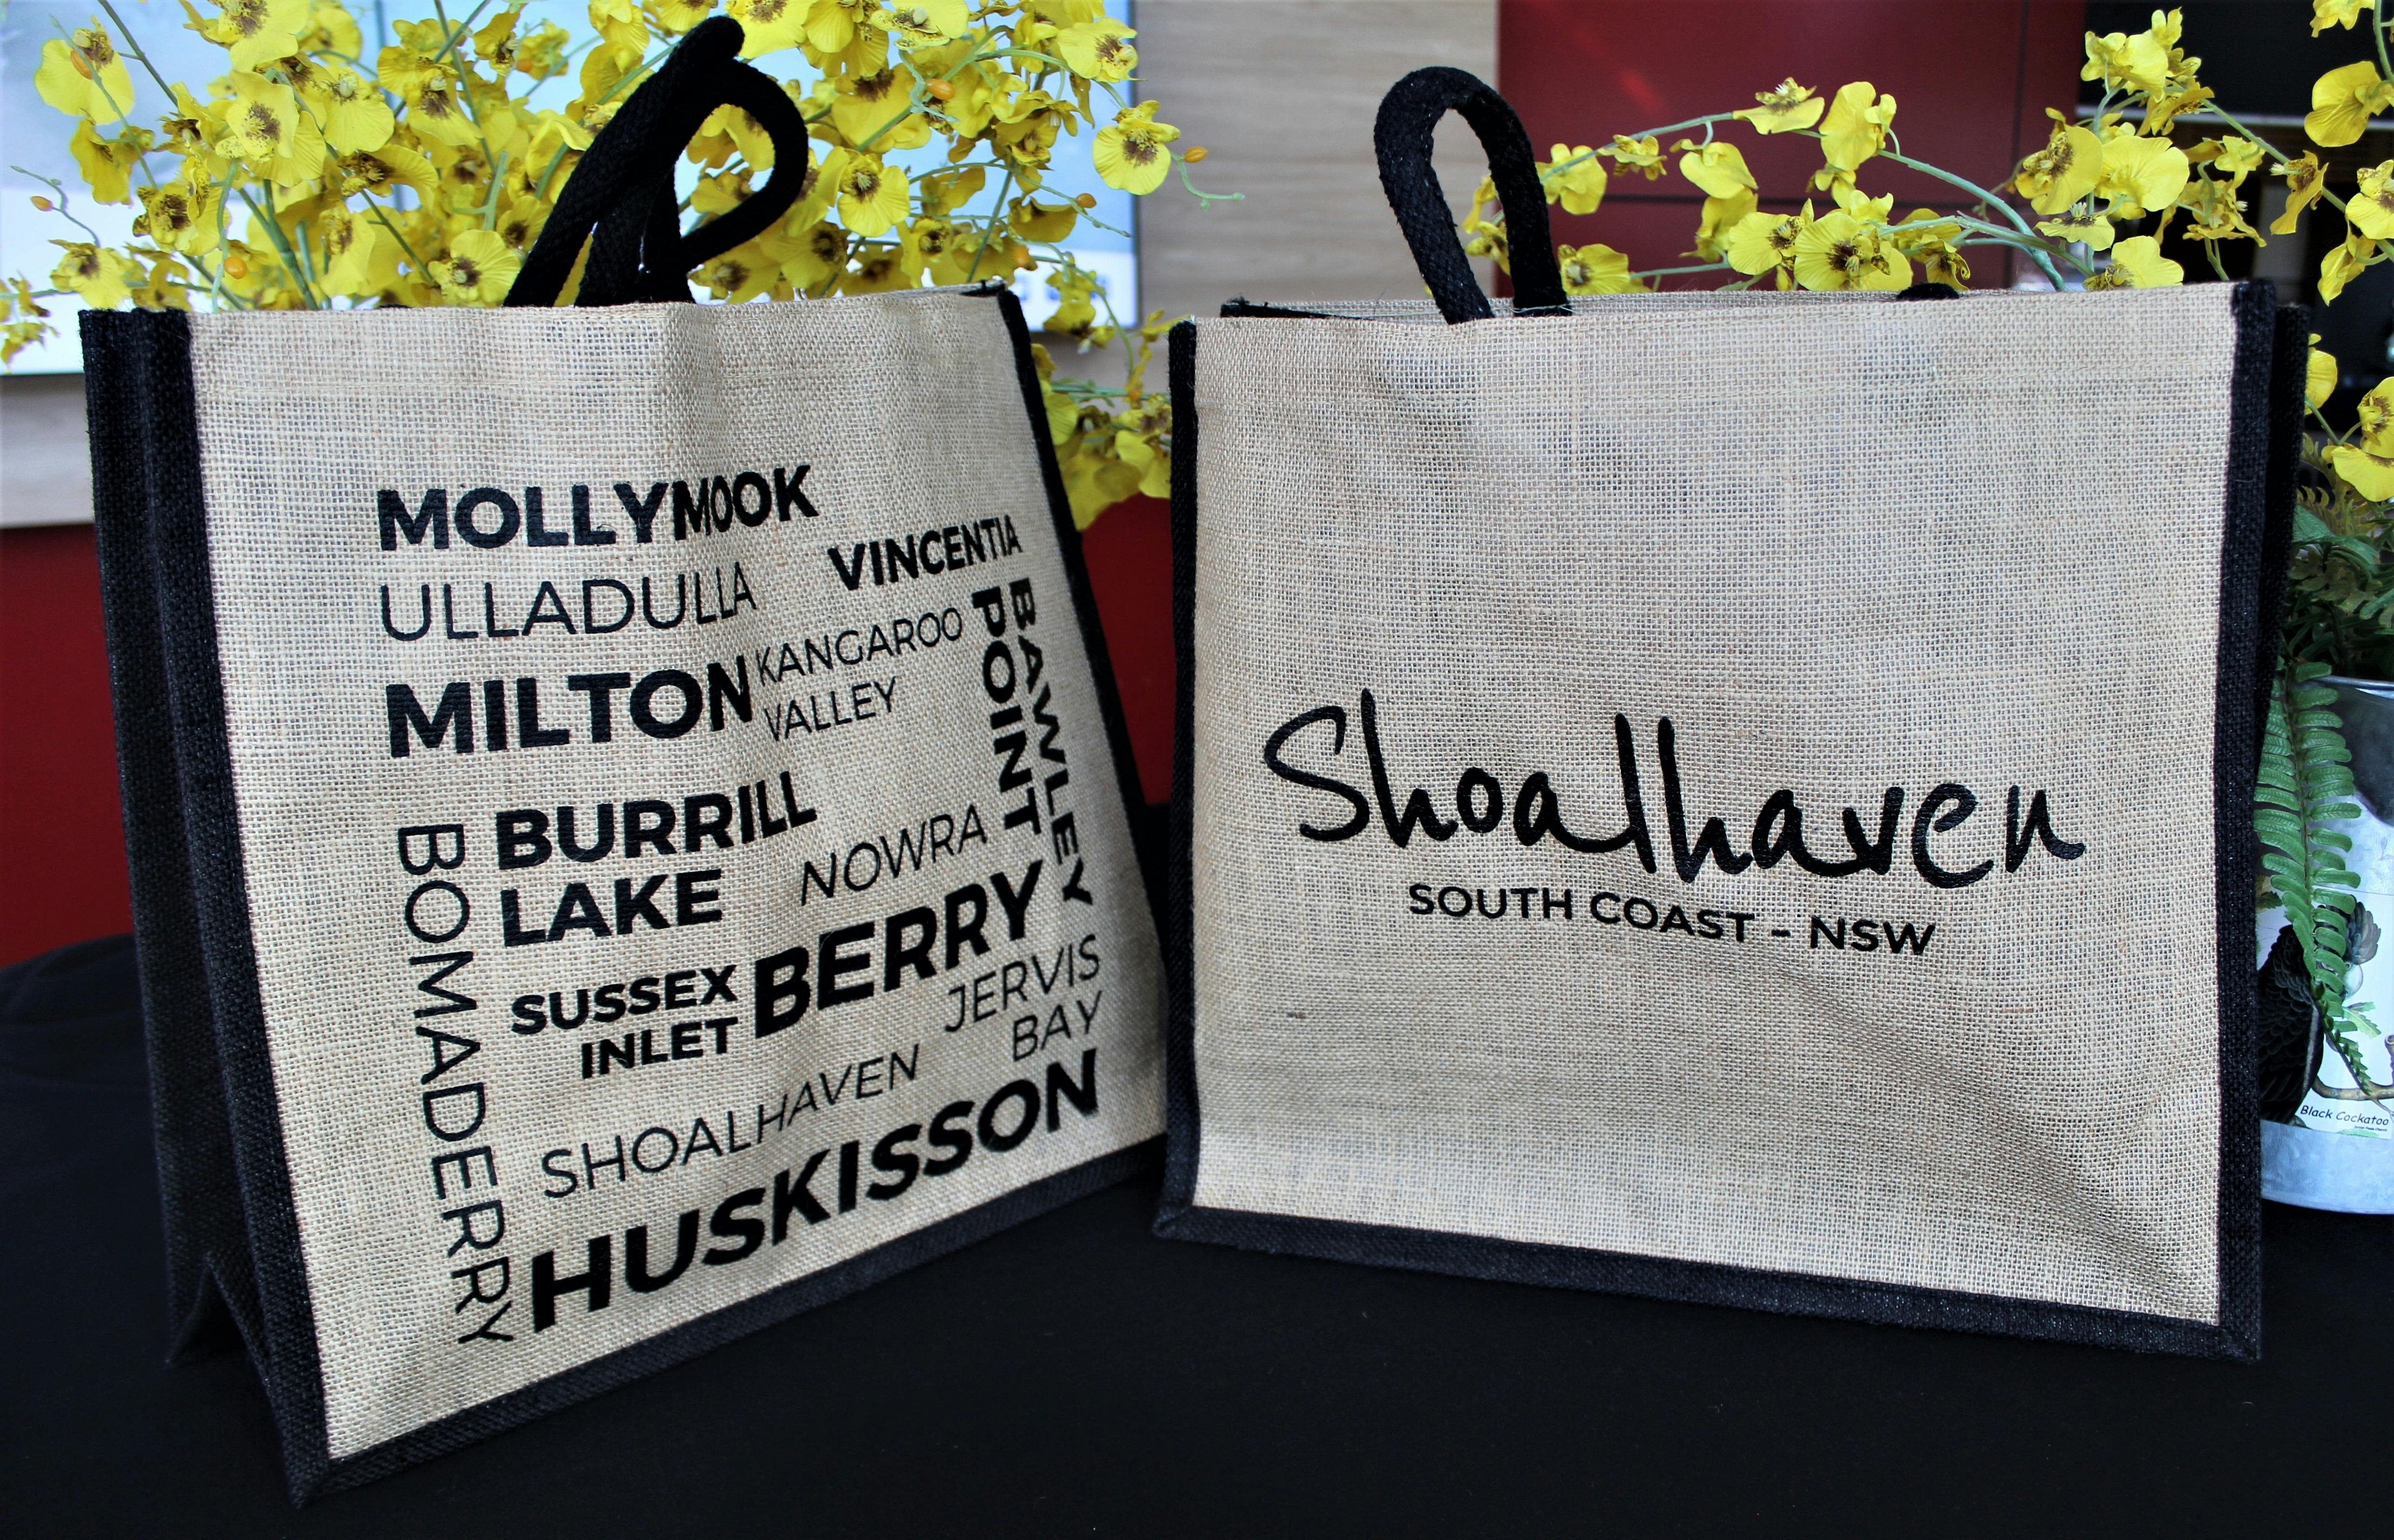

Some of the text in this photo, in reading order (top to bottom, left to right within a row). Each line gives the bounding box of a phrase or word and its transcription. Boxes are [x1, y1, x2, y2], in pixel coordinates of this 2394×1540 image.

[377, 464, 819, 551] MOLLYMOOK
[826, 514, 1023, 591] VINCENTIA
[380, 561, 758, 642] ULLADULLA
[755, 606, 964, 686] KANGAROO
[386, 654, 753, 758] MILTON
[763, 677, 896, 742] VALLEY
[971, 585, 1042, 836] POINT
[1008, 577, 1094, 906] BAWLEY
[495, 770, 818, 871] BURRILL
[1263, 688, 2086, 889] Shoalhaven
[800, 803, 988, 906] NOWRA
[500, 868, 723, 947] LAKE
[754, 858, 1044, 1039] BERRY
[1408, 883, 1574, 921] SOUTH
[1589, 891, 1756, 943] COAST
[1809, 915, 1936, 956] NSW
[512, 964, 738, 1036] SUSSEX
[944, 933, 1101, 1035] JERVIS
[1012, 989, 1103, 1062] BAY
[397, 823, 515, 1345] BOMADERRY
[581, 1016, 739, 1080] INLET
[542, 1043, 920, 1199] SHOALHAVEN
[2300, 1105, 2389, 1126] Black Cockatoo
[530, 1046, 1099, 1334] HUSKISSON
